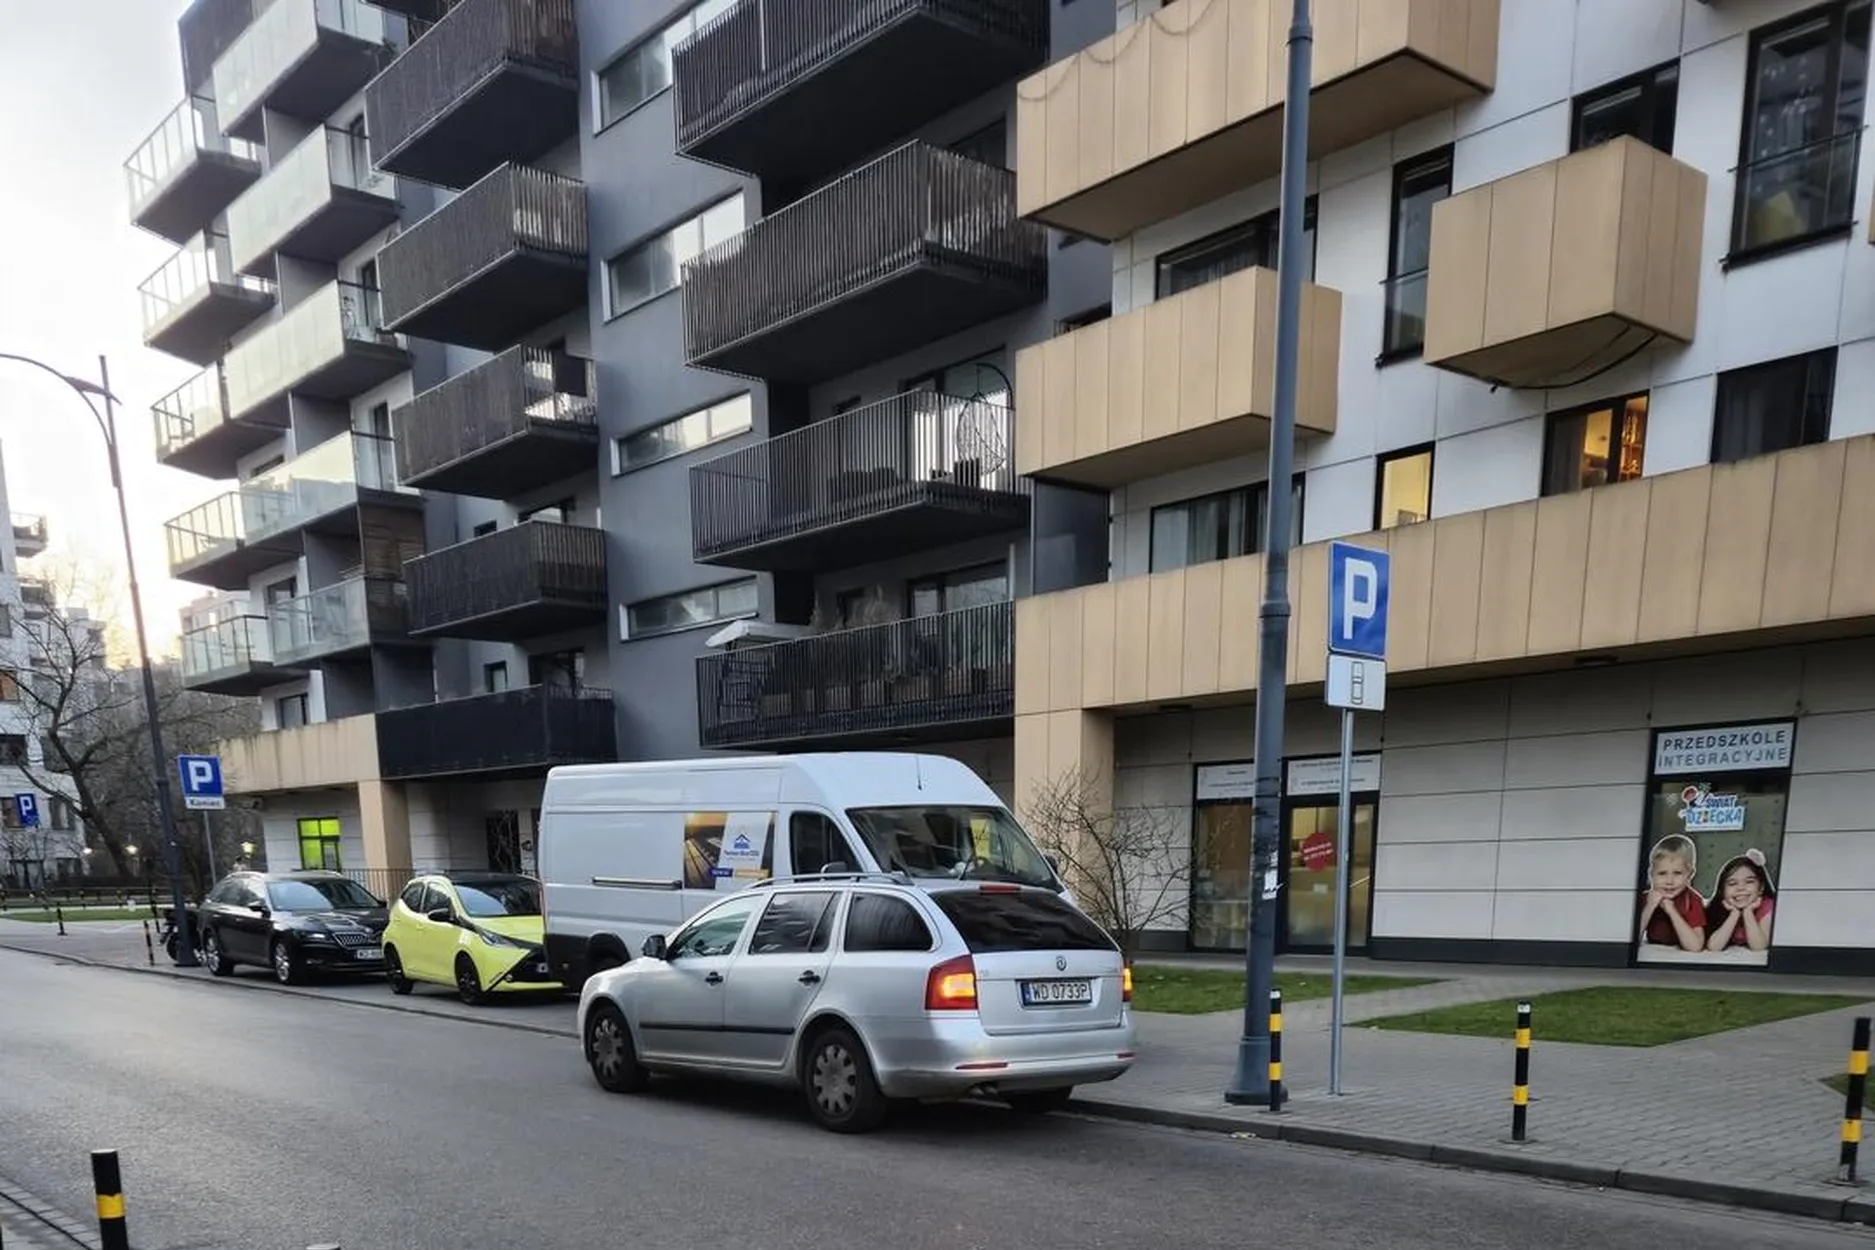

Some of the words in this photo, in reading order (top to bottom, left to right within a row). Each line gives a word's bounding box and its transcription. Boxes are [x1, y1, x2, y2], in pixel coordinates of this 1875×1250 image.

[1343, 557, 1378, 640] P
[1663, 730, 1786, 751] PRZEDSZKOLE
[1657, 748, 1788, 768] INTEGRACYJNE
[188, 760, 213, 791] P
[19, 795, 33, 817] P
[1032, 984, 1049, 1001] WD
[1051, 983, 1088, 1000] 0733P
